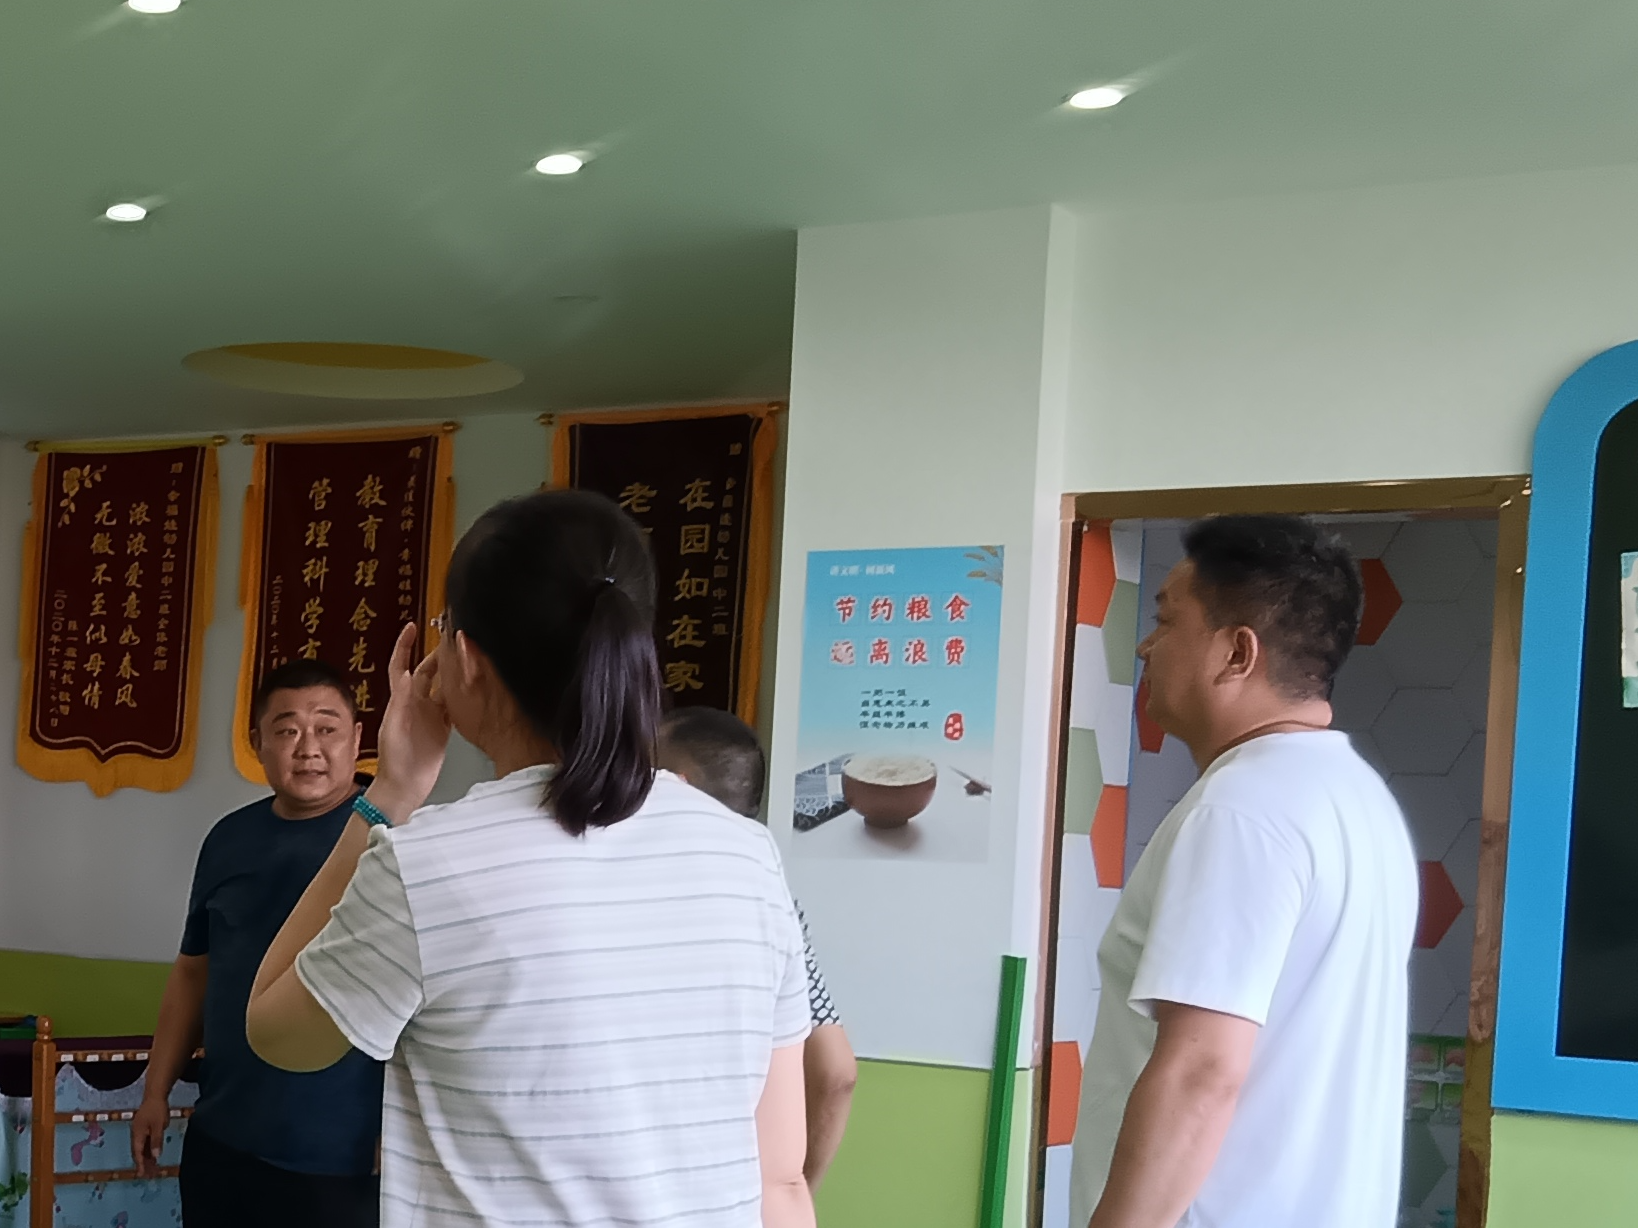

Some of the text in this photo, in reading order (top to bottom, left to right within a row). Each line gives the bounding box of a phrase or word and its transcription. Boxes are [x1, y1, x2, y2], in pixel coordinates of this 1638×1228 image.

[81, 500, 118, 710] 无微不至似母情
[115, 501, 152, 709] 浓浓爱意如春风
[348, 473, 388, 713] 教育理念先进
[663, 477, 715, 692] 在园如在家
[831, 637, 966, 666] 远离浪费
[835, 594, 971, 623] 节约粮食
